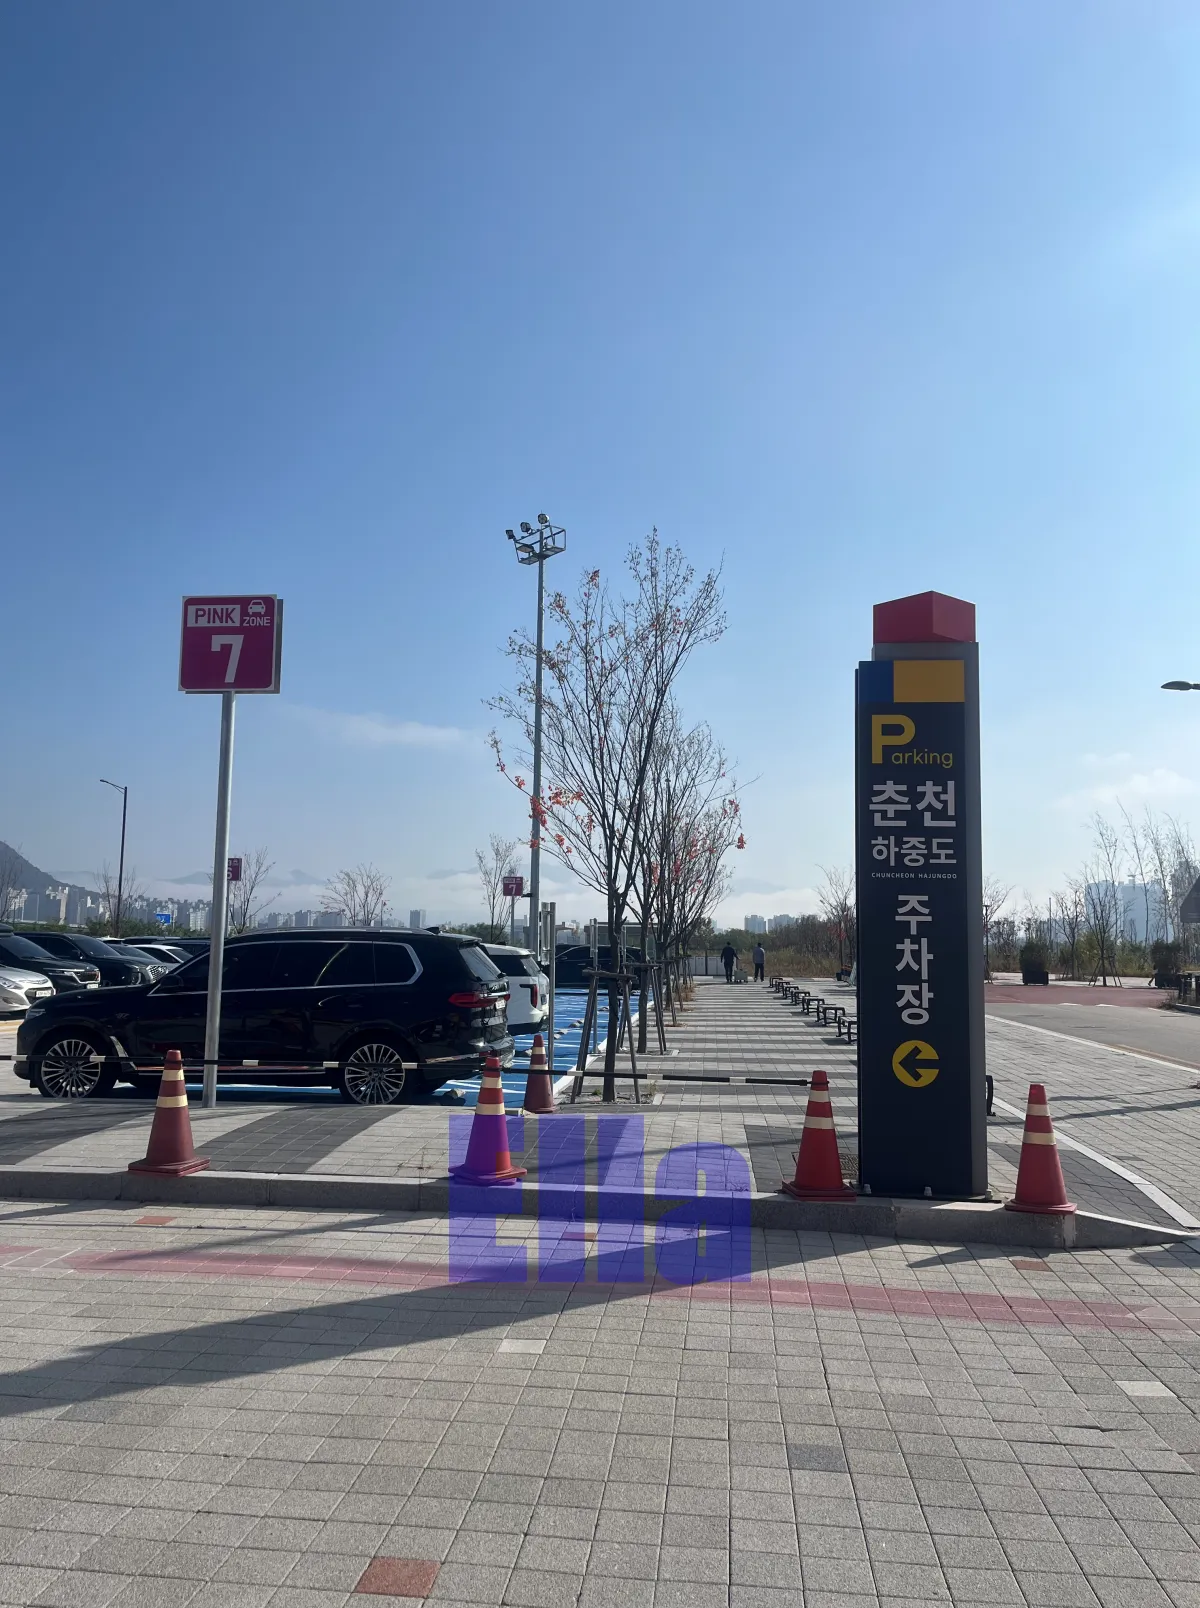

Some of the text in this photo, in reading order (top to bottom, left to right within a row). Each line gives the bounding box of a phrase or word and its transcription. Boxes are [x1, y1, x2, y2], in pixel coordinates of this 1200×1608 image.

[195, 607, 270, 626] PINK ZONE
[211, 635, 244, 683] 7
[871, 714, 953, 768] Parking
[869, 780, 957, 827] 춘천
[871, 835, 957, 866] 하중도
[509, 884, 516, 895] 7
[895, 895, 934, 1025] 주차장
